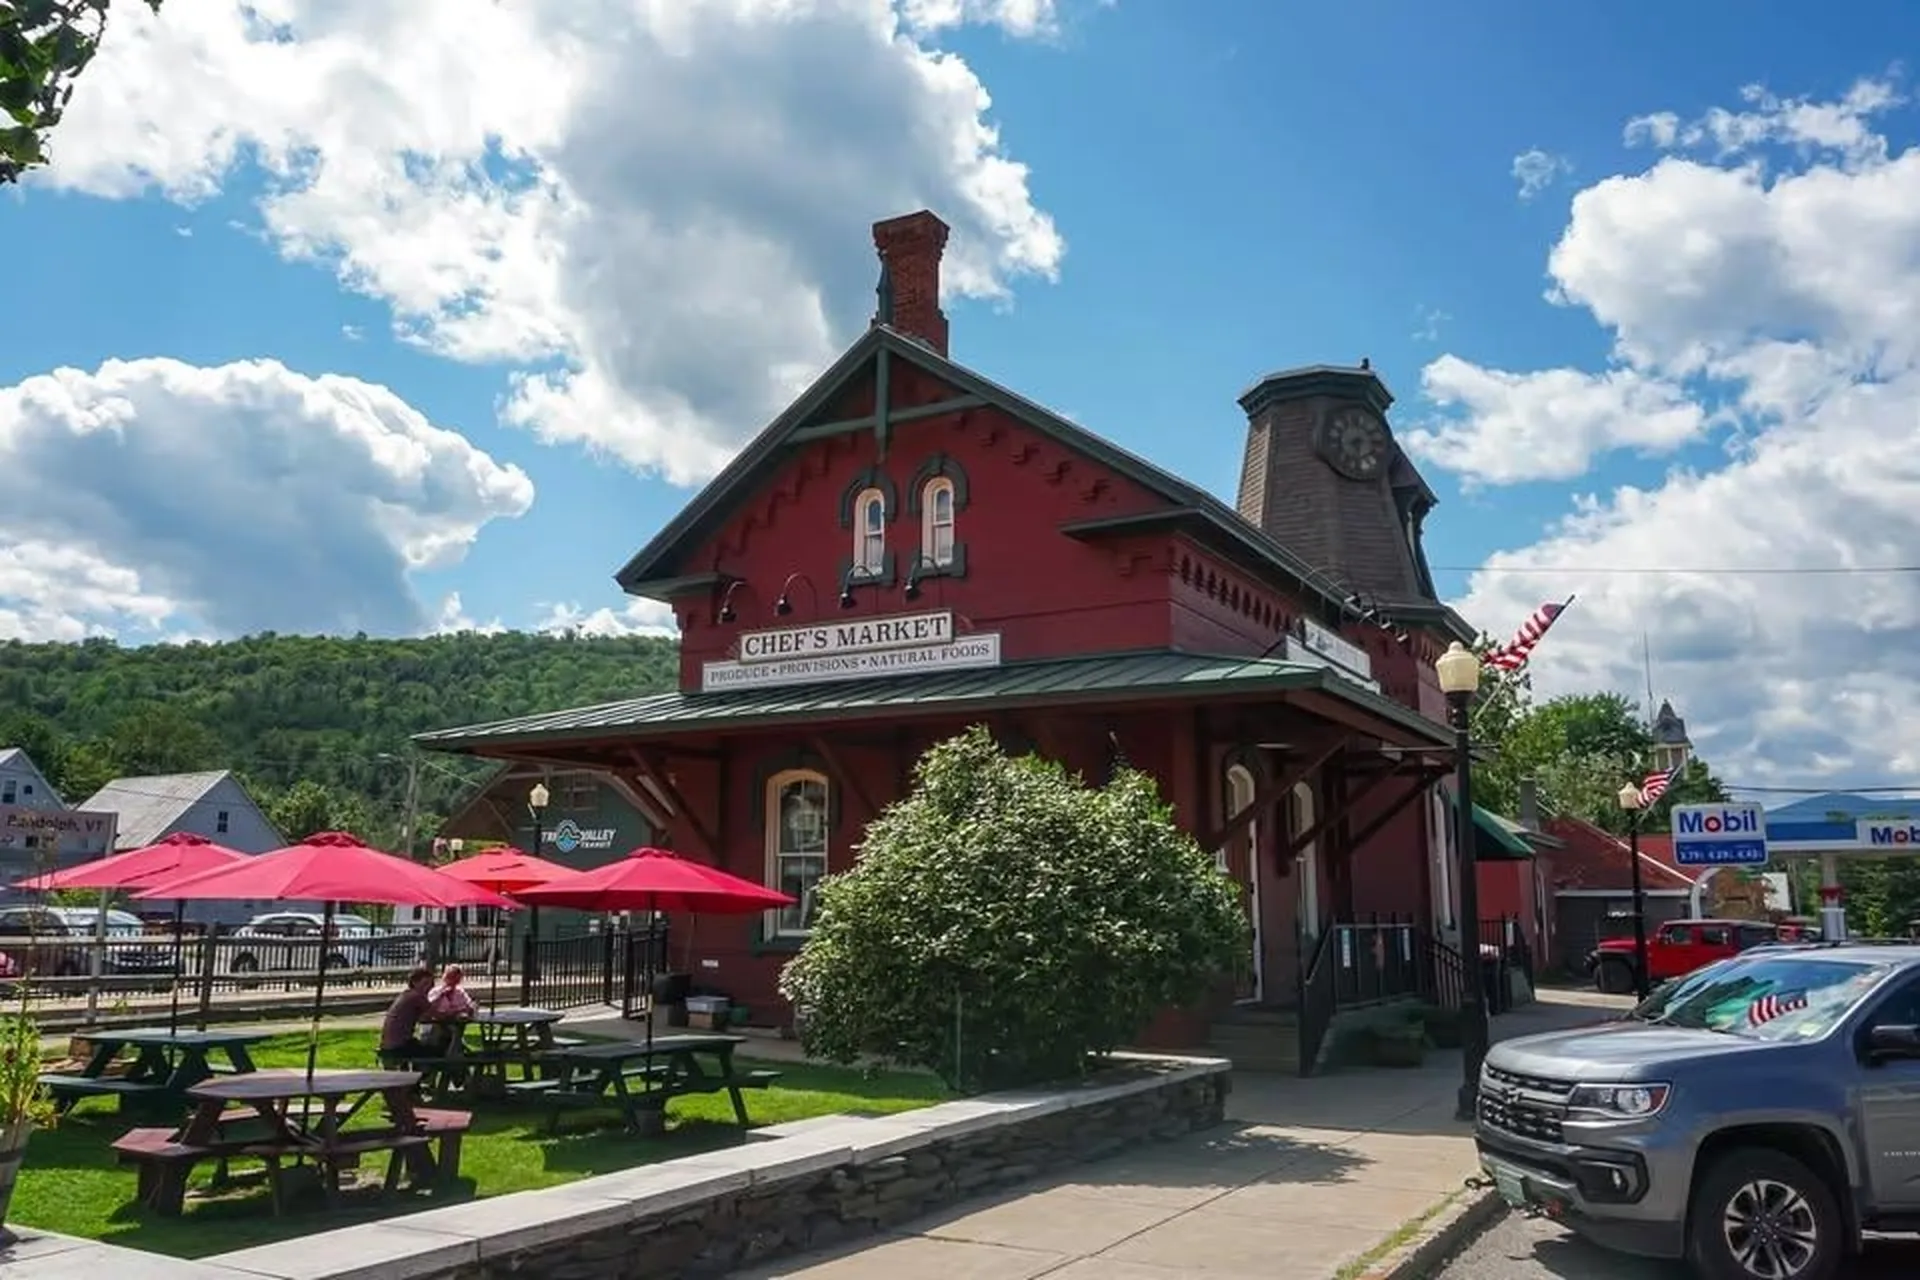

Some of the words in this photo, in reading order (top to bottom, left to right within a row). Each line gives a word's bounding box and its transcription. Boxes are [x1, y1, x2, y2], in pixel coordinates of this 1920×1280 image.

[745, 629, 828, 656] CHEF'S
[837, 615, 948, 648] MARKET
[711, 665, 770, 683] PRODUCE
[778, 658, 859, 676] PROVISIONS
[869, 649, 937, 668] NATURAL
[942, 642, 990, 661] FOODS
[580, 829, 617, 841] VALLEY
[1678, 808, 1758, 834] Mobil
